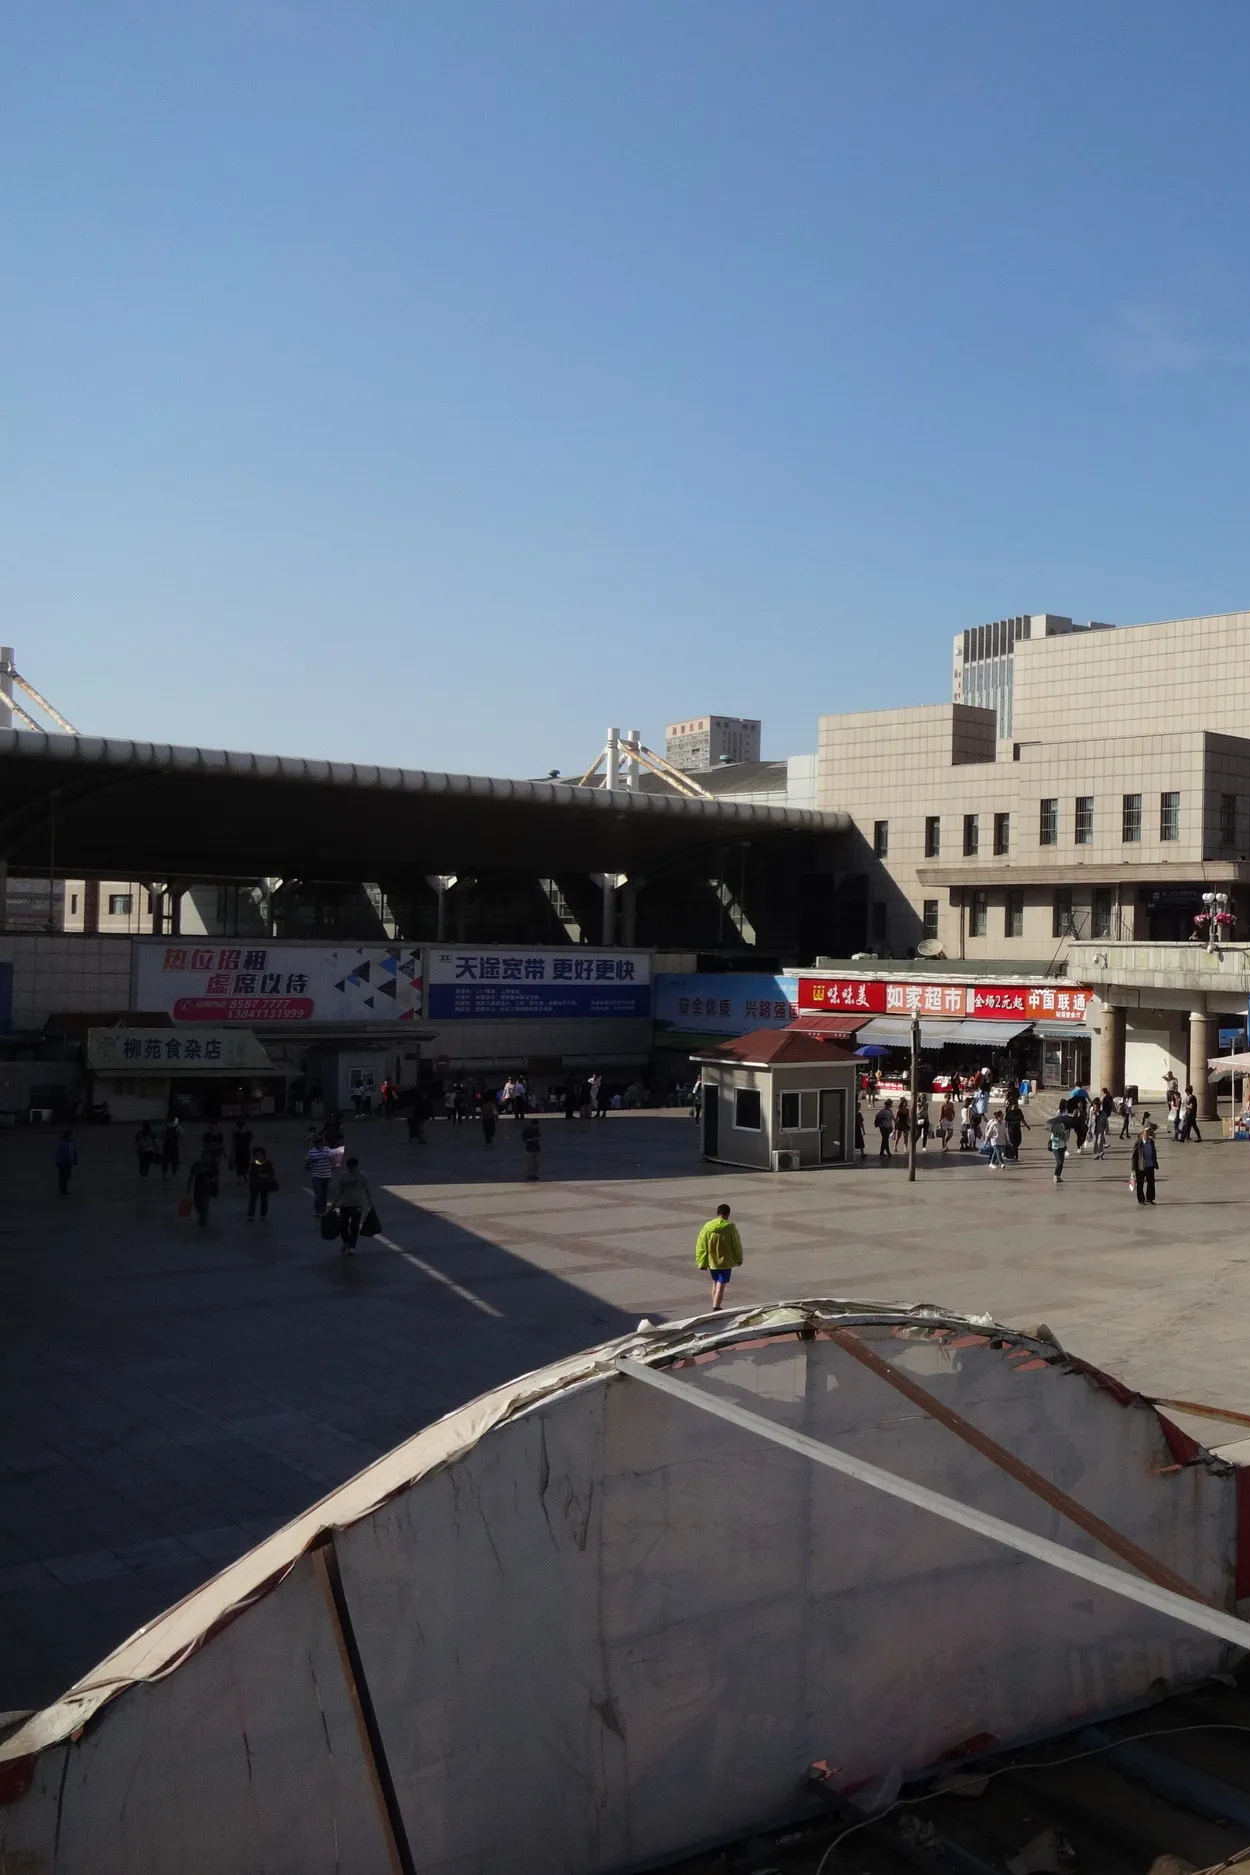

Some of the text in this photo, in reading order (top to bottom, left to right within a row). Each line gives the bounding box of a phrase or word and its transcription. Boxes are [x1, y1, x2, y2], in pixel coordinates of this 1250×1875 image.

[455, 957, 634, 980] 天途宽带 更好更快
[206, 973, 308, 994] 虚席以待
[679, 997, 733, 1017] 安全优质
[826, 987, 871, 1008] 味味美
[887, 985, 963, 1013] 如家超市
[974, 994, 1025, 1010] 全场2元起
[1028, 993, 1086, 1011] 中国联通
[124, 1038, 221, 1060] 柳苑食杂店
